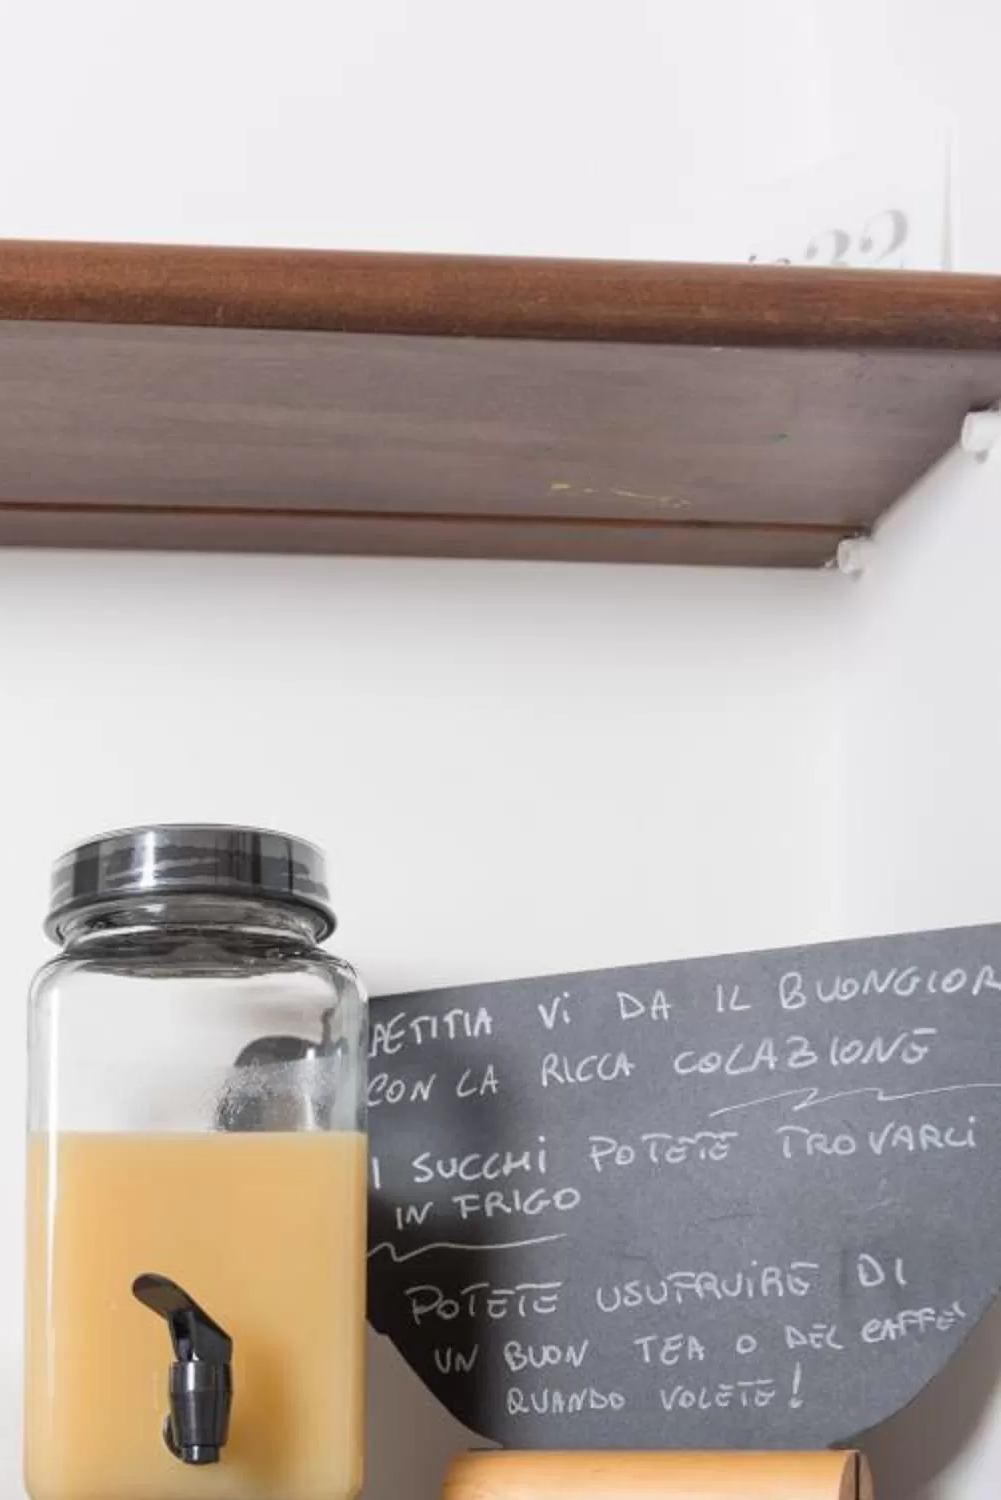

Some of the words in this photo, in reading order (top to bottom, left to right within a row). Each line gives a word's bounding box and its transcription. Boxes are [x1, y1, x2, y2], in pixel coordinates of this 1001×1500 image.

[367, 1006, 493, 1058] AETITIA
[616, 988, 672, 1022] DA
[715, 983, 752, 1013] IL
[366, 1072, 437, 1107] CON
[455, 1063, 499, 1098] LA
[540, 1050, 636, 1088] RICCA
[673, 1027, 938, 1076] COLAZIONE
[371, 1155, 382, 1191] I
[588, 1132, 739, 1173] POTETE
[395, 1200, 435, 1231] IN
[451, 1186, 581, 1220] FRIGO
[403, 1281, 563, 1326] POTETE
[856, 1252, 908, 1287] DI
[434, 1343, 479, 1375] UN
[503, 1338, 589, 1373] BUON
[632, 1332, 707, 1366] TEA
[735, 1334, 758, 1355] O
[784, 1322, 846, 1350] DEL
[505, 1386, 627, 1416] QUANDO
